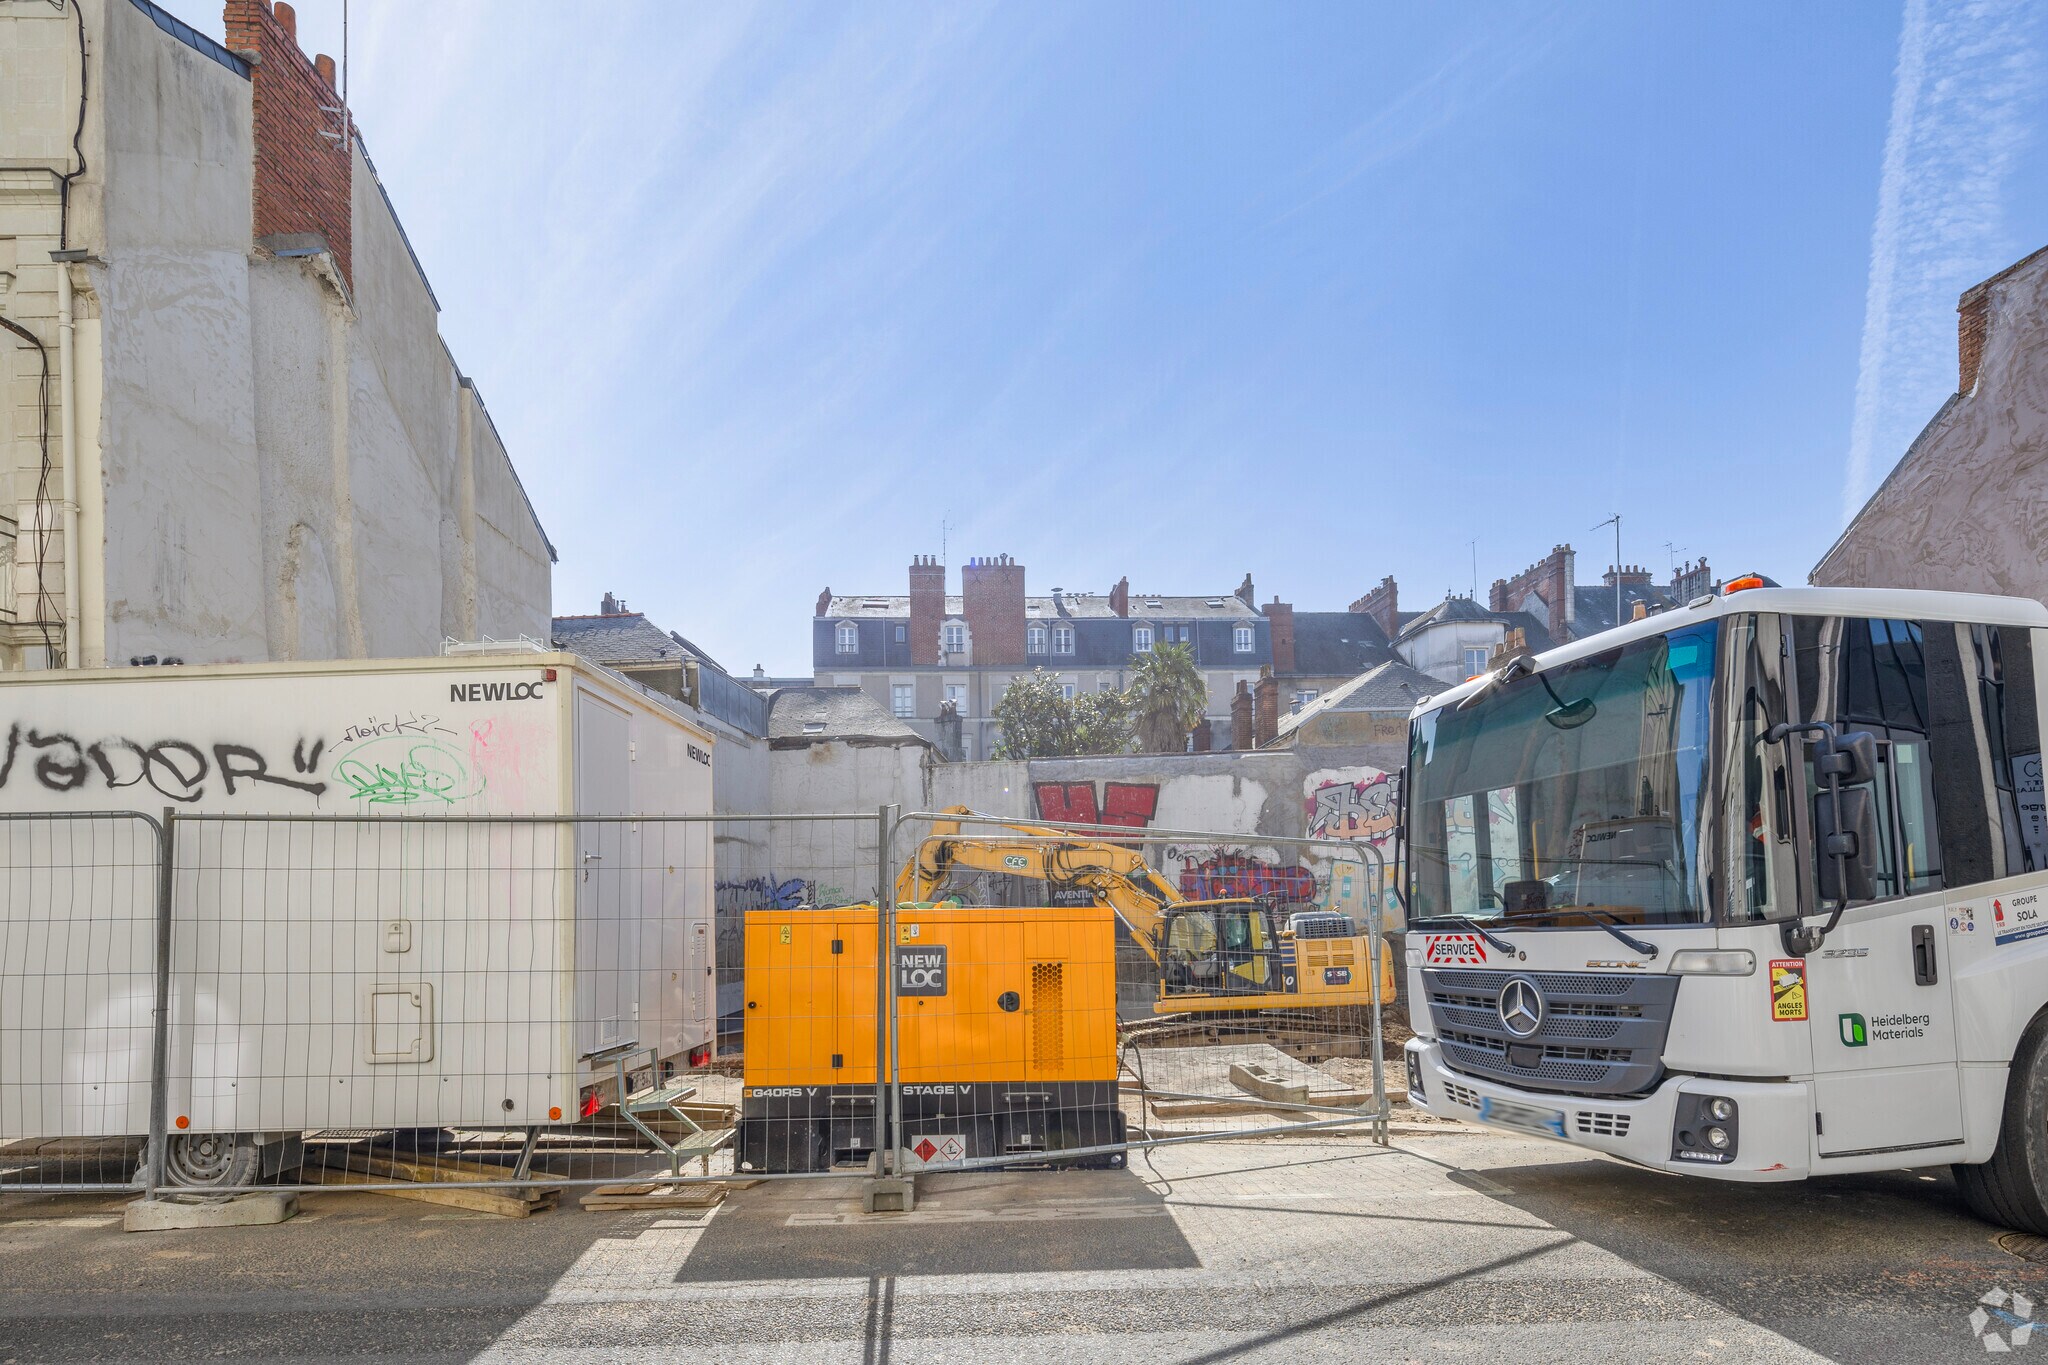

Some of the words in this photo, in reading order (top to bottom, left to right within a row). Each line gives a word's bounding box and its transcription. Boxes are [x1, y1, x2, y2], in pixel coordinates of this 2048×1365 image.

[450, 681, 544, 703] NEWLOC
[2011, 894, 2038, 907] GROUPE
[2016, 909, 2038, 921] SOLA
[1435, 943, 1475, 956] SERVICE
[901, 954, 942, 968] NEW
[901, 968, 942, 988] LOC
[1871, 1013, 1930, 1027] Heidelberg
[1872, 1026, 1924, 1041] Materials
[752, 1087, 802, 1097] G40RS
[903, 1086, 954, 1096] STAGE
[959, 1085, 972, 1095] V
